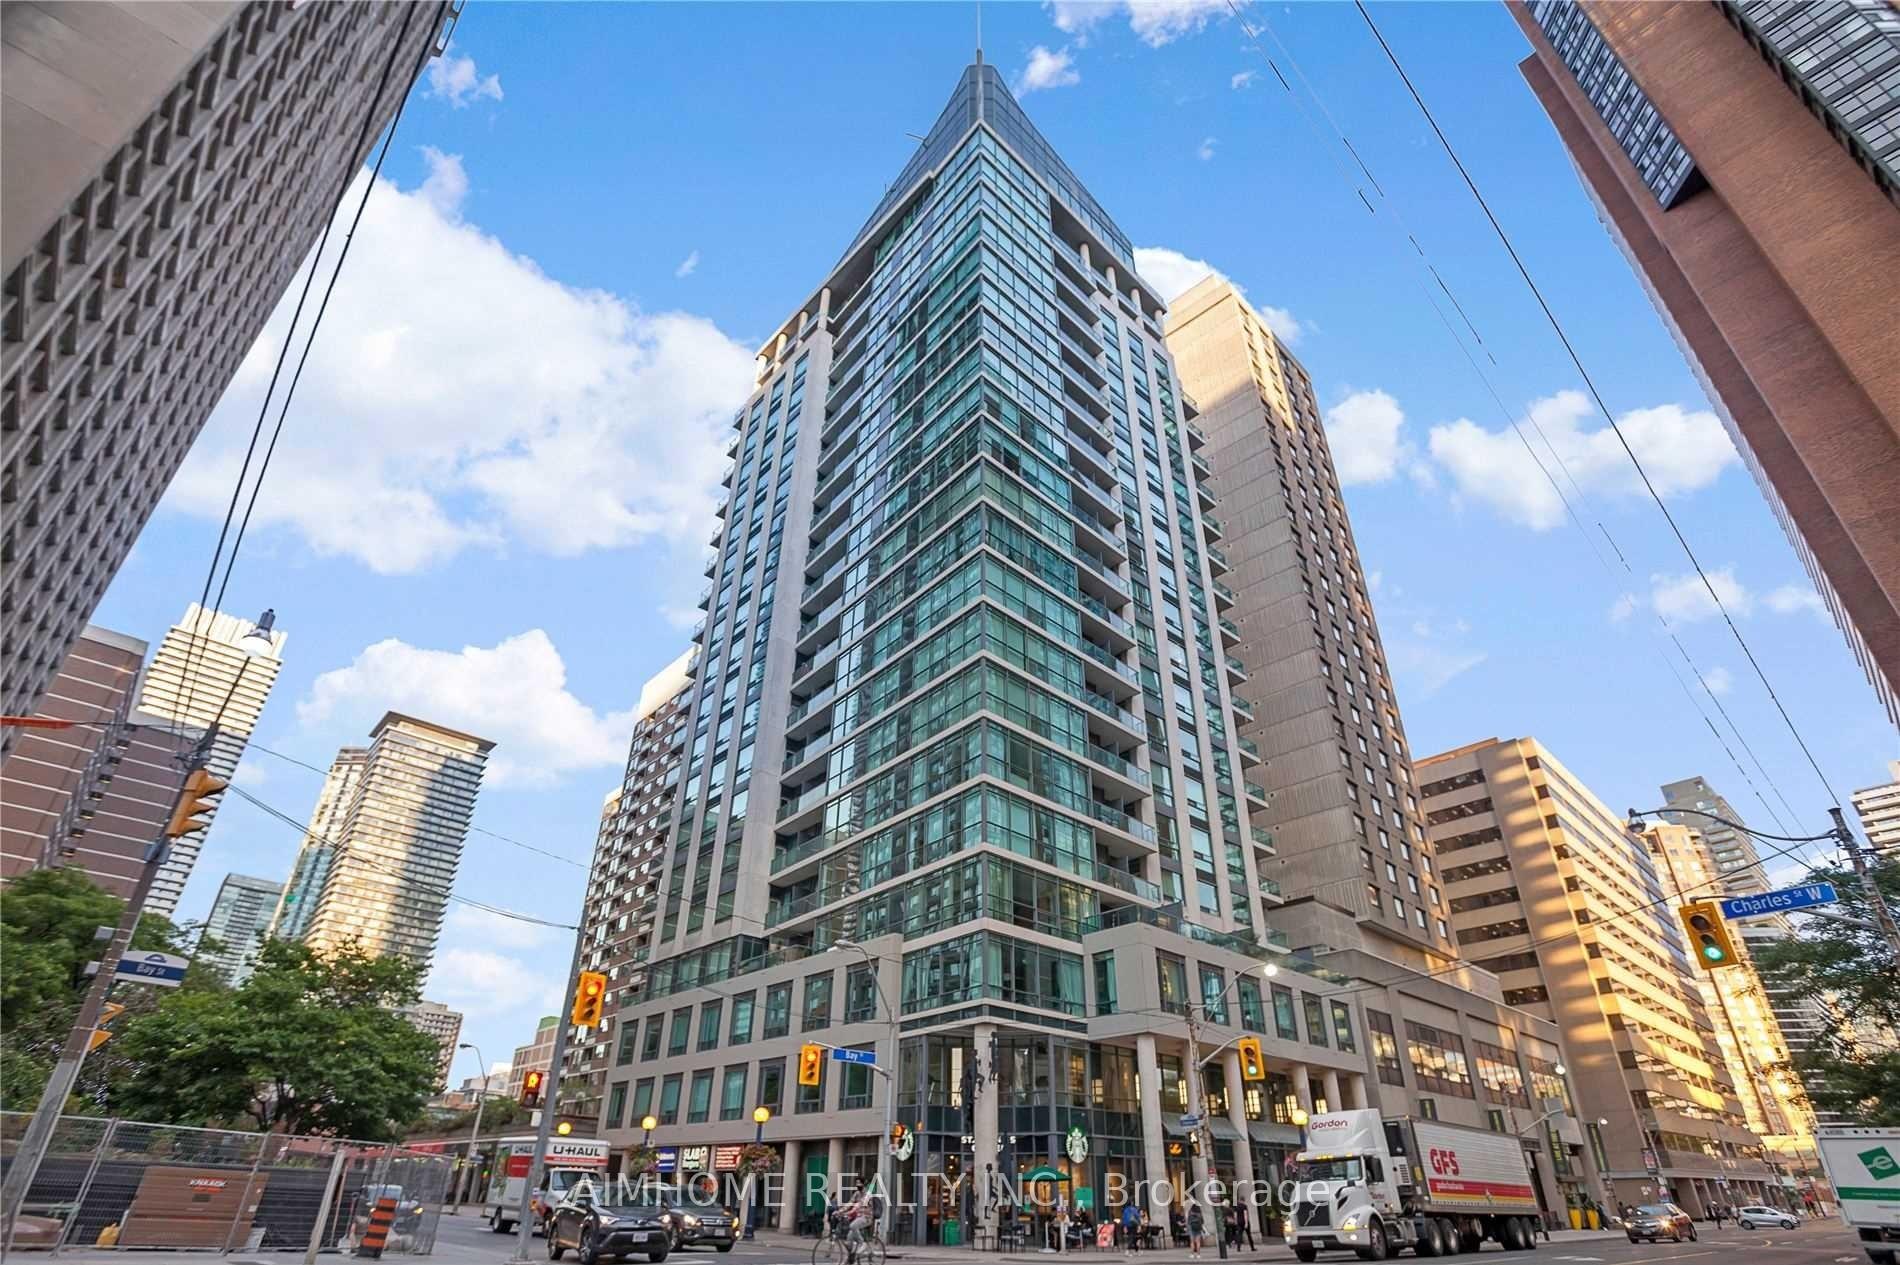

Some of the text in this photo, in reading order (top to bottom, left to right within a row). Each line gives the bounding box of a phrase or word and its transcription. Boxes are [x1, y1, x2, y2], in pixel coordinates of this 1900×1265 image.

[1731, 894, 1792, 913] Charles
[1806, 886, 1822, 901] W
[136, 963, 155, 976] Bay
[1312, 1119, 1348, 1130] Gordon
[553, 1145, 601, 1157] U-HAUL
[1429, 1148, 1460, 1176] GFS
